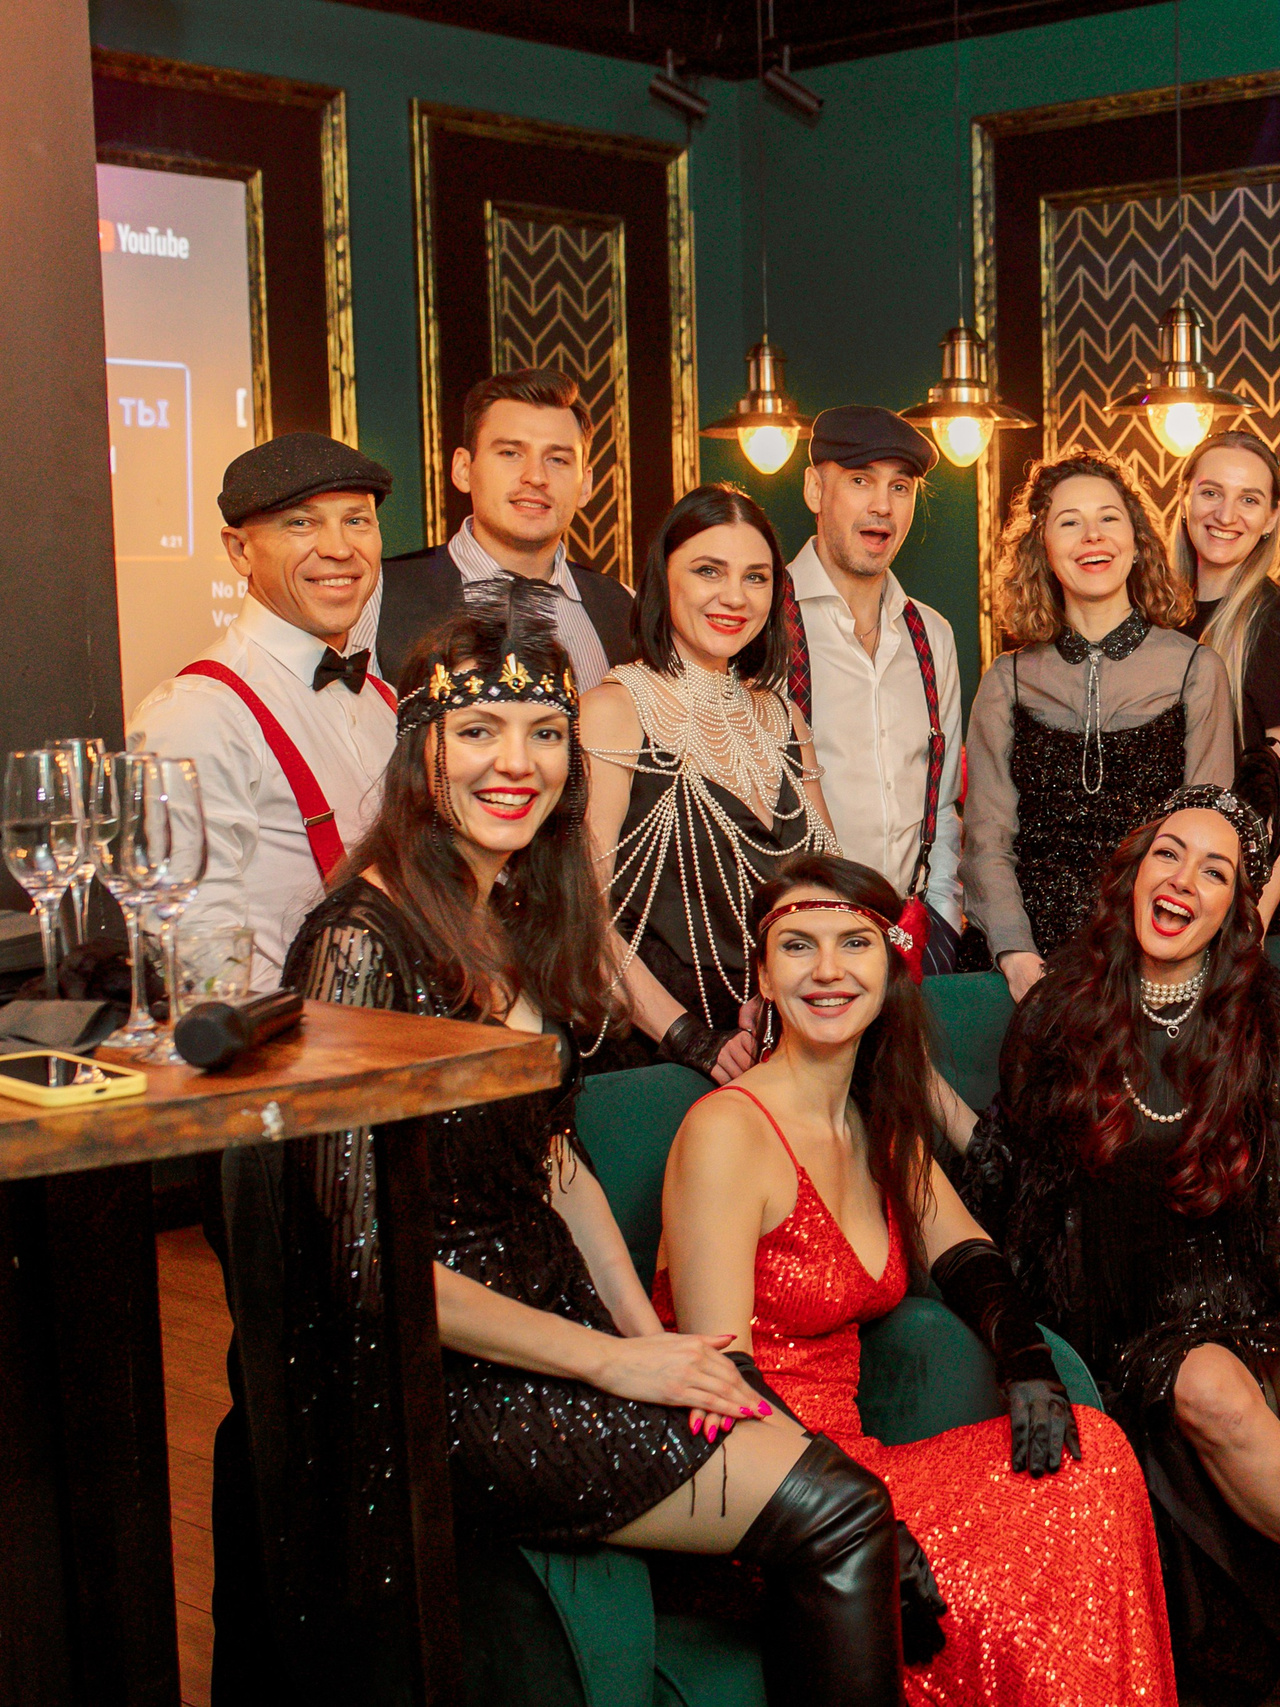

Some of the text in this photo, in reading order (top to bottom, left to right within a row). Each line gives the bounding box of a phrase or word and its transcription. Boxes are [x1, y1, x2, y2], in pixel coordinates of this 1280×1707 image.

[116, 222, 190, 259] YouTube
[118, 397, 169, 428] ТЫ
[211, 580, 234, 599] No
